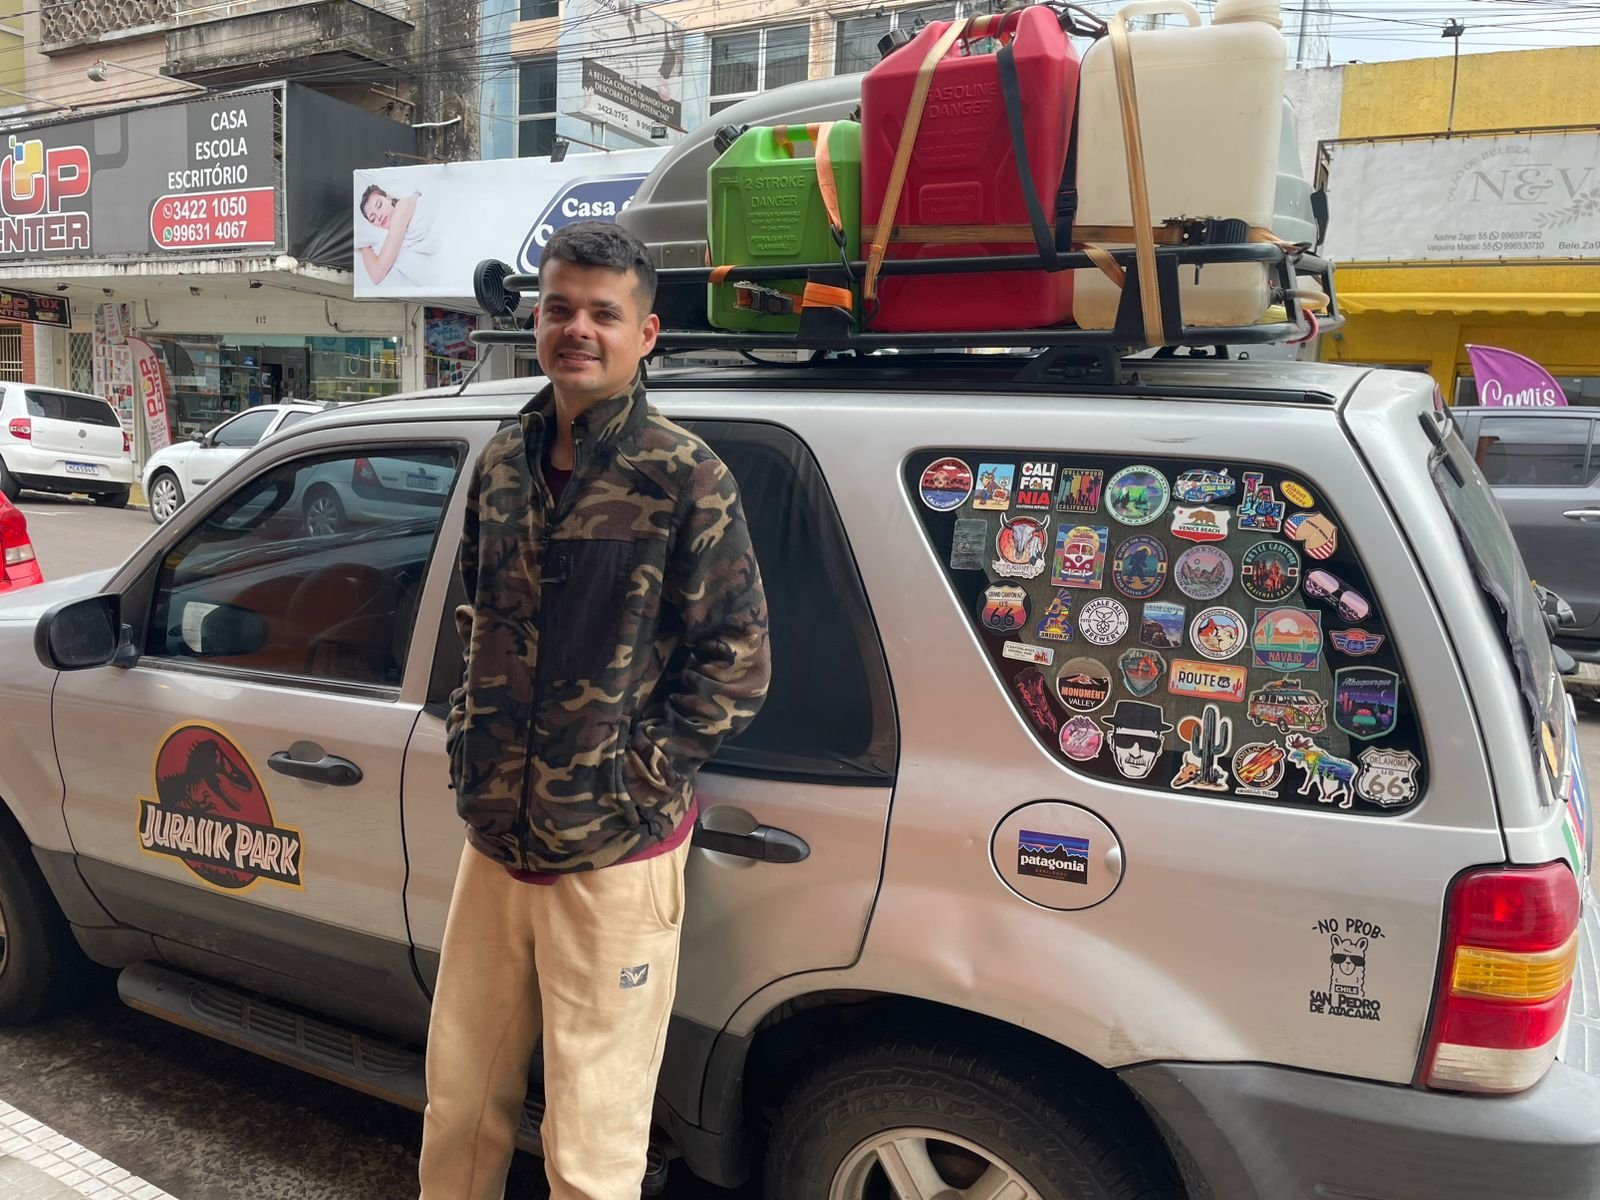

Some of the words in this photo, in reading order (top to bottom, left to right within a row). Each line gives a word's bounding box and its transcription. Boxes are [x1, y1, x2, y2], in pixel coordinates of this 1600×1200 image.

[614, 80, 637, 98] COMEÇA
[637, 91, 660, 108] QUANDO
[929, 100, 990, 118] DANGER
[211, 109, 248, 131] CASA
[196, 137, 248, 160] ESCOLA
[168, 163, 248, 189] ESCRITÓRIO
[744, 178, 752, 189] 2
[755, 175, 805, 189] STROKE
[173, 199, 207, 220] 3422
[212, 196, 247, 217] 1050
[562, 197, 616, 218] Casa
[751, 195, 798, 208] DANGER
[0, 211, 91, 252] NTER
[173, 223, 210, 242] 99631
[215, 221, 247, 239] 4067
[1478, 232, 1488, 240] 55
[1482, 242, 1492, 250] 55
[1022, 462, 1056, 477] CALI
[1020, 477, 1053, 491] FOR
[926, 495, 960, 508] CALIFORNIA
[1017, 491, 1051, 505] NIA
[1245, 544, 1266, 563] BRYCE
[1268, 543, 1297, 565] CANYON
[1183, 586, 1217, 598] NATIONAL
[1217, 577, 1230, 592] PARK
[1085, 600, 1110, 614] WHALE
[1111, 602, 1124, 616] TAIL
[990, 607, 1015, 626] 66
[1040, 631, 1070, 640] ARIZONA
[1085, 629, 1121, 642] BREWERY
[1225, 645, 1239, 656] PARK
[1268, 651, 1302, 662] NAVAJO
[1178, 671, 1217, 687] ROUTE
[1341, 677, 1392, 688] Albuquerque
[1061, 686, 1106, 700] MONUMENT
[1068, 698, 1096, 707] VALLEY
[1369, 755, 1409, 768] OKLAHOMA
[1368, 774, 1404, 797] 66
[234, 822, 299, 877] PARK
[1020, 855, 1085, 872] patagonia
[1335, 985, 1359, 994] CHILE
[1310, 990, 1332, 1006] SAN
[1338, 993, 1381, 1012] PEDRO
[1310, 1002, 1324, 1014] DE
[1328, 1006, 1381, 1021] ATACAMA
